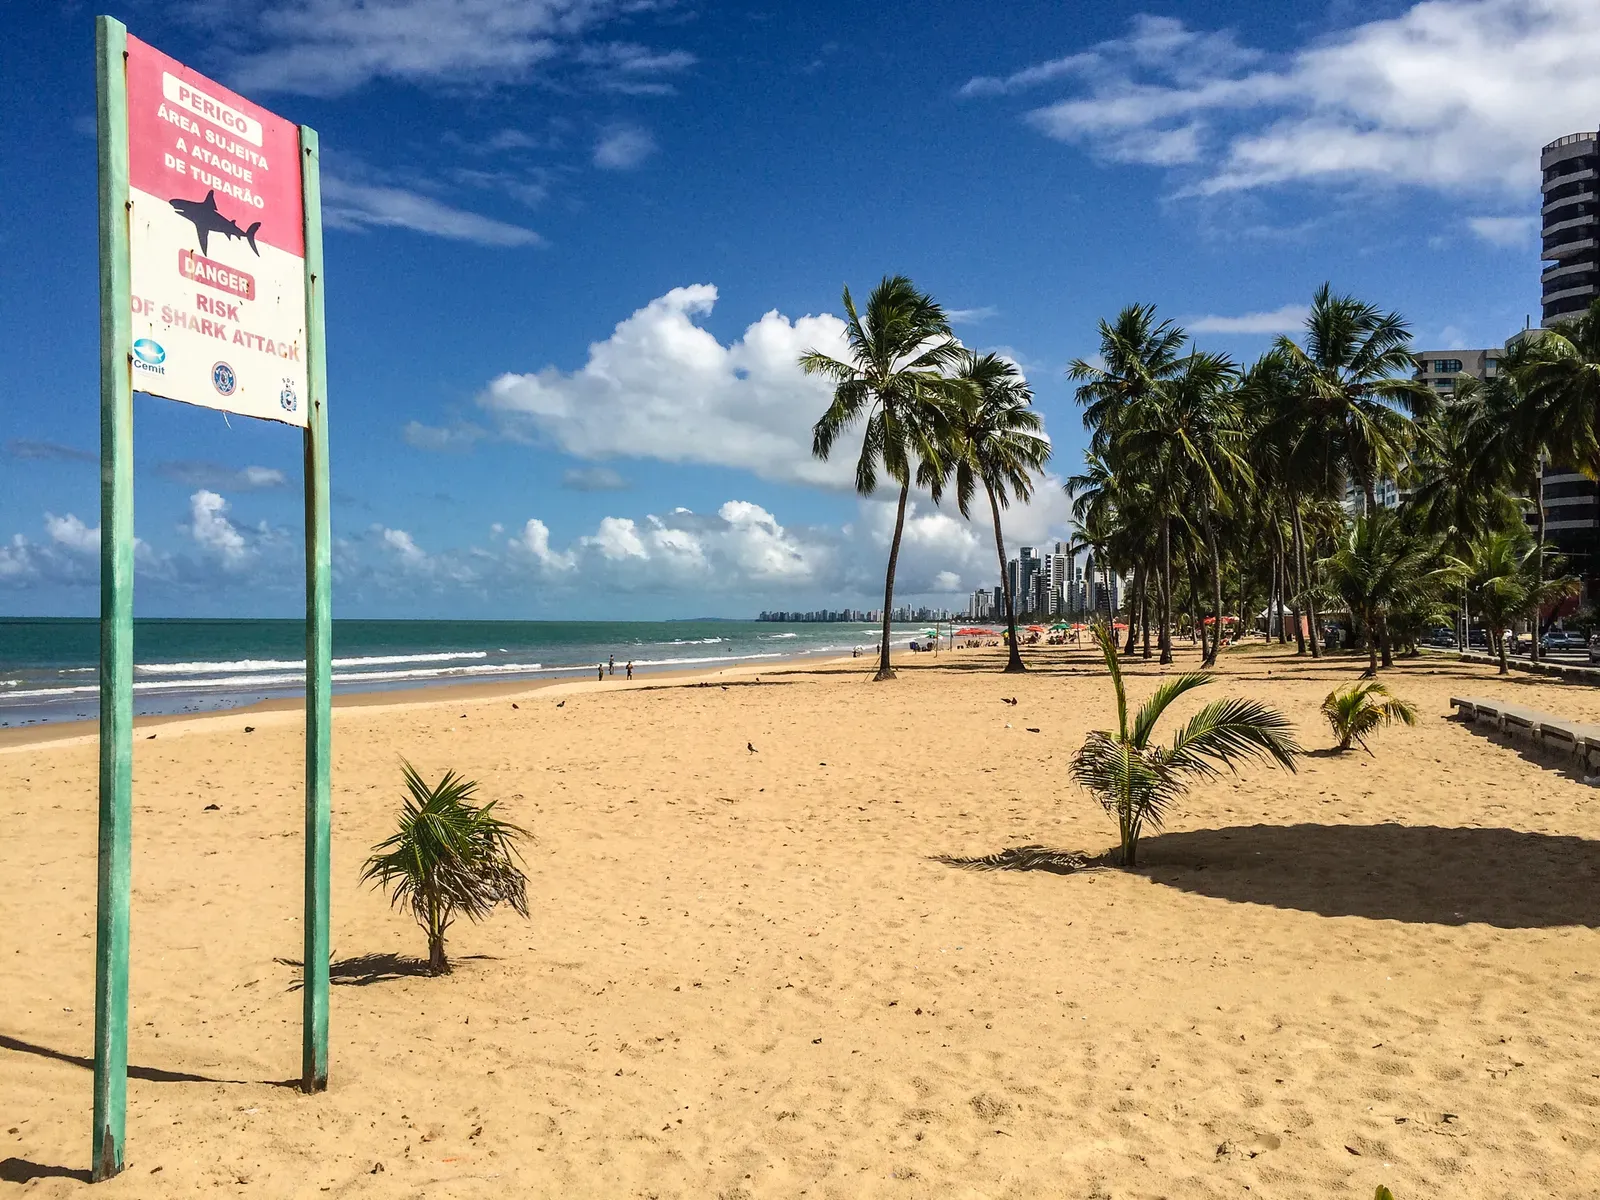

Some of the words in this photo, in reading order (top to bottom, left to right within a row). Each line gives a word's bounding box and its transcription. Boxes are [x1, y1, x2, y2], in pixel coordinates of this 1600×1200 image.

[179, 86, 248, 134] PERIGO
[157, 103, 200, 138] ÁREA
[205, 129, 269, 171] SUJEITA
[165, 153, 186, 175] DE
[190, 165, 264, 209] TUBARÃO
[176, 138, 187, 153] A
[191, 145, 253, 185] ATAQUE
[185, 256, 249, 294] DANGER
[131, 295, 154, 316] OF
[161, 305, 227, 341] SHARK
[232, 329, 300, 363] ATTACK
[196, 293, 240, 323] RISK
[134, 360, 165, 375] Cemit
